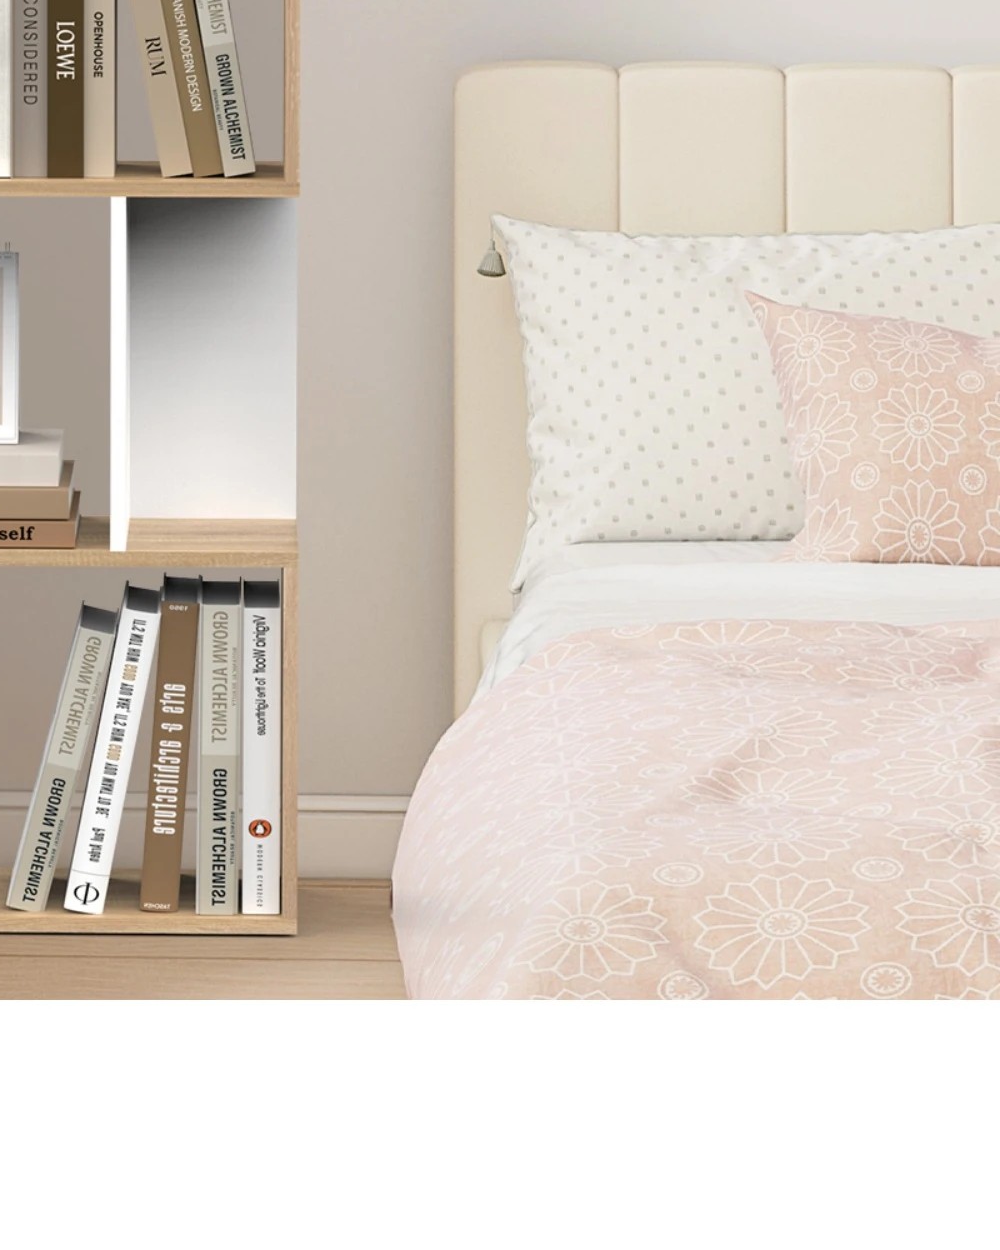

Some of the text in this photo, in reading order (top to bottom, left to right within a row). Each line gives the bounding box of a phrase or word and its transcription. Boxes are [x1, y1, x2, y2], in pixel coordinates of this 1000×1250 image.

[56, 21, 76, 81] LOEWE
[93, 11, 104, 78] OPENHOUSE
[144, 36, 167, 78] RUM
[177, 27, 195, 74] MODERN
[185, 73, 203, 112] DESIGN
[215, 53, 246, 161] GROWN ALCHEMIST
